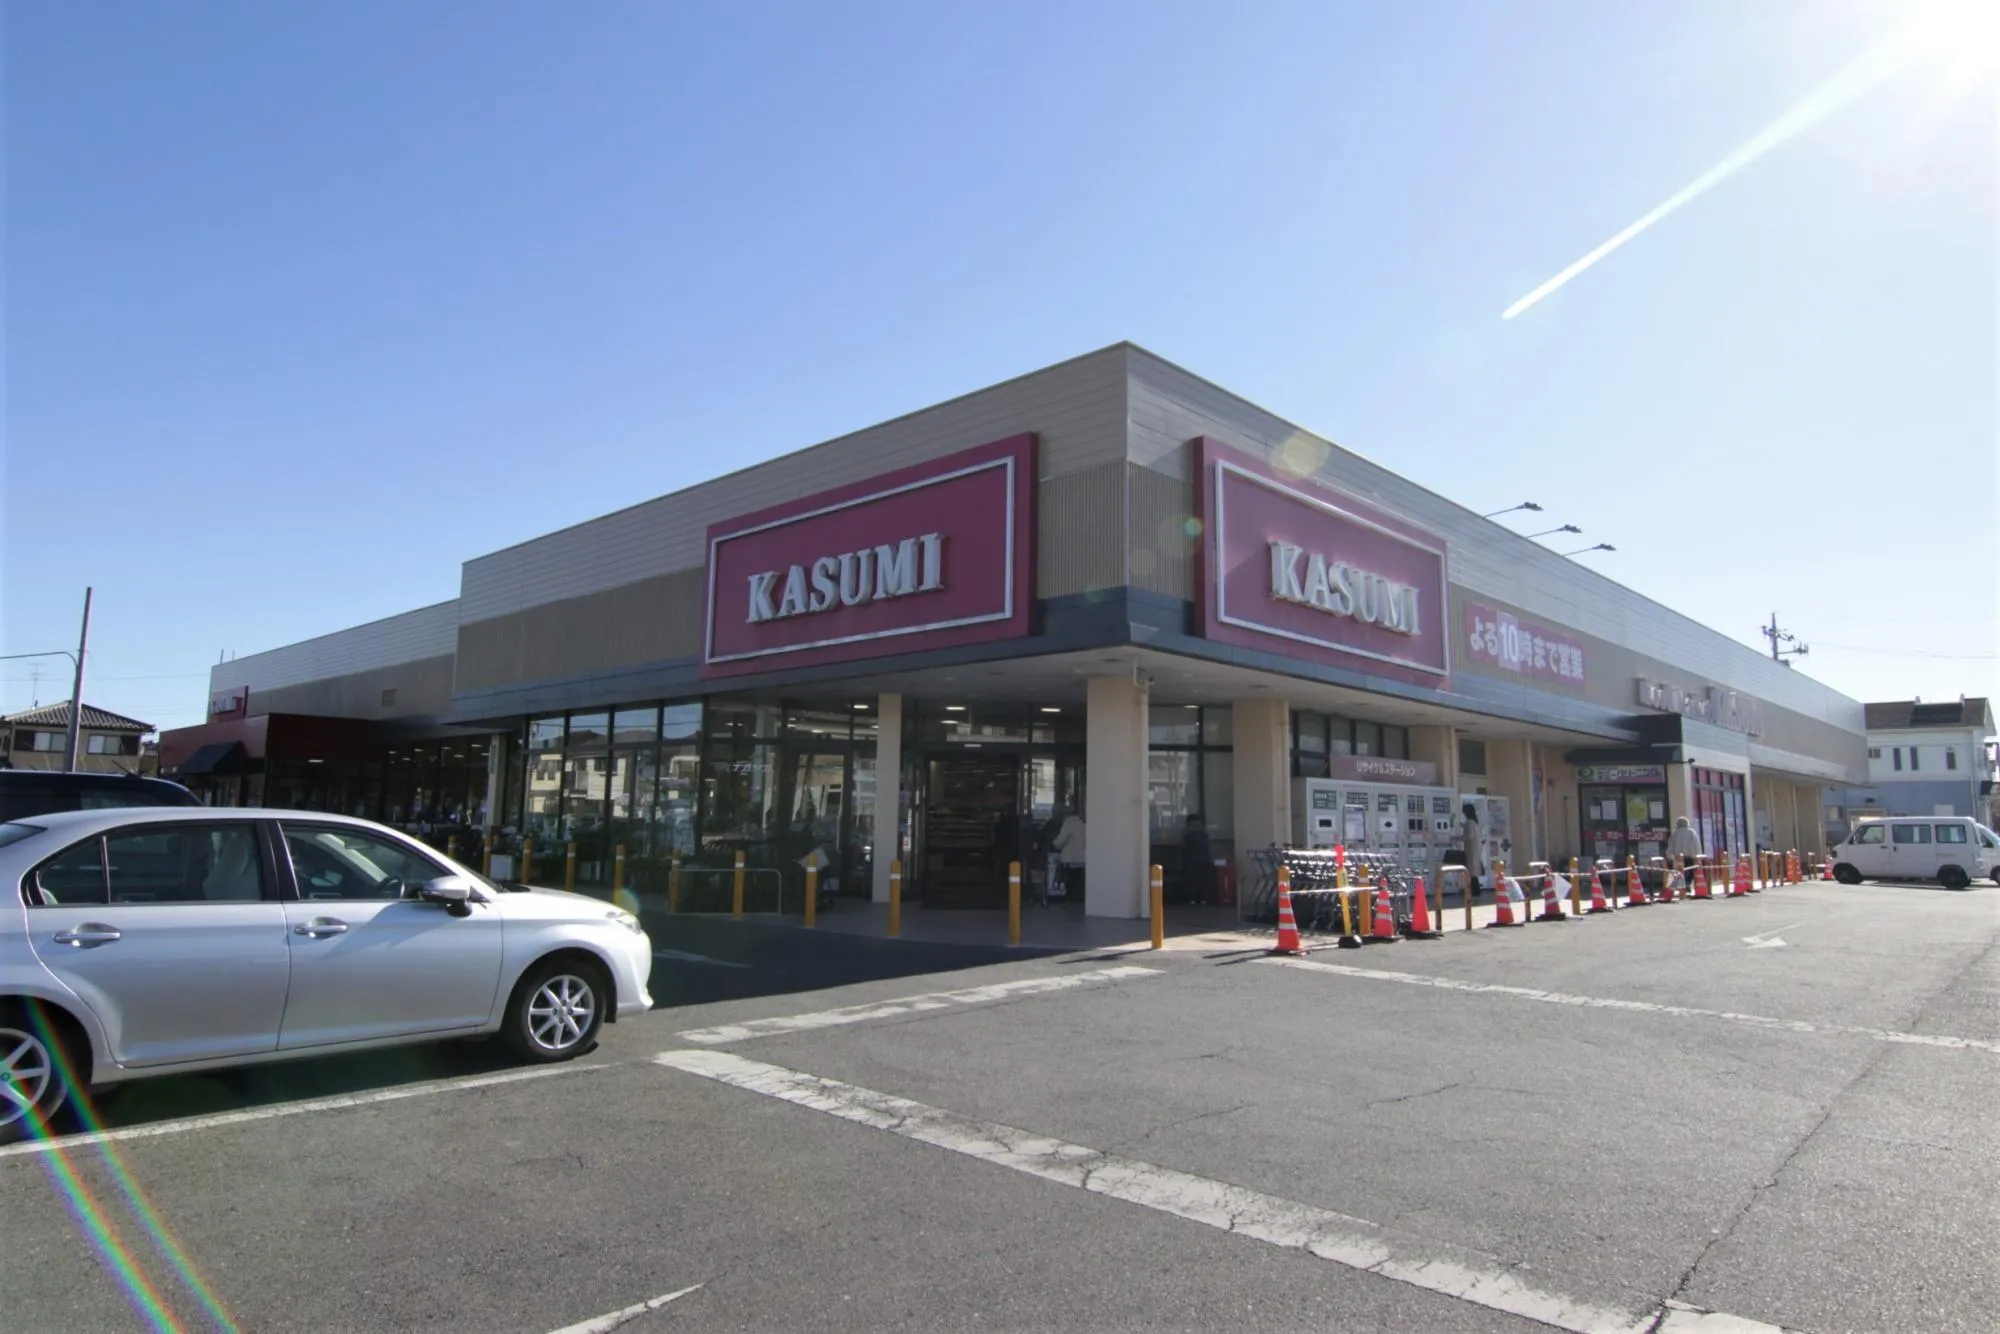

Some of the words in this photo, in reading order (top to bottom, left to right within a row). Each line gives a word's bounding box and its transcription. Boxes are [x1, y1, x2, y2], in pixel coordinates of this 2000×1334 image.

[746, 532, 946, 623] KASUMI
[1267, 538, 1421, 635] KASUMI
[1470, 616, 1583, 681] よる10時まで営業
